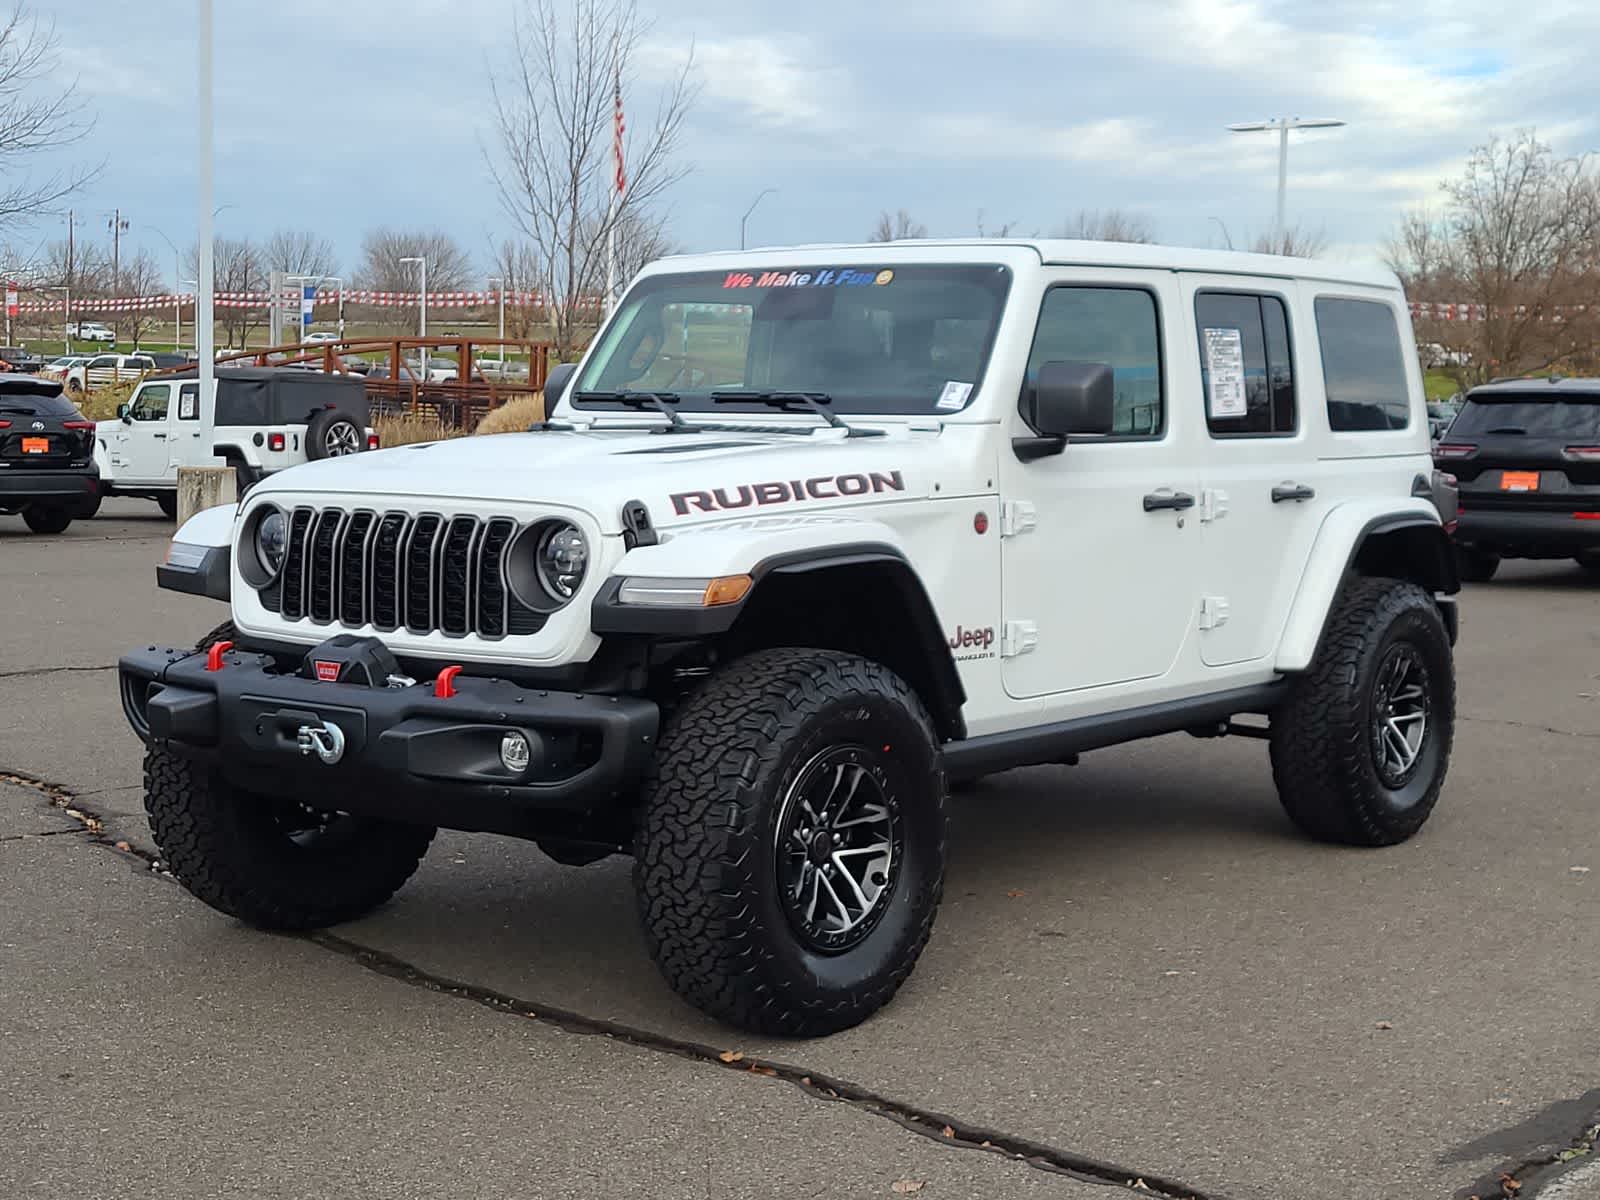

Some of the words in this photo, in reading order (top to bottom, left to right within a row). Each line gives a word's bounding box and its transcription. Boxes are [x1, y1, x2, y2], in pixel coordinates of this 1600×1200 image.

[723, 272, 754, 288] We
[756, 271, 810, 287] Make
[813, 270, 834, 286] It
[834, 269, 876, 285] Fun
[669, 470, 905, 516] RUBICON
[950, 625, 994, 650] Jeep
